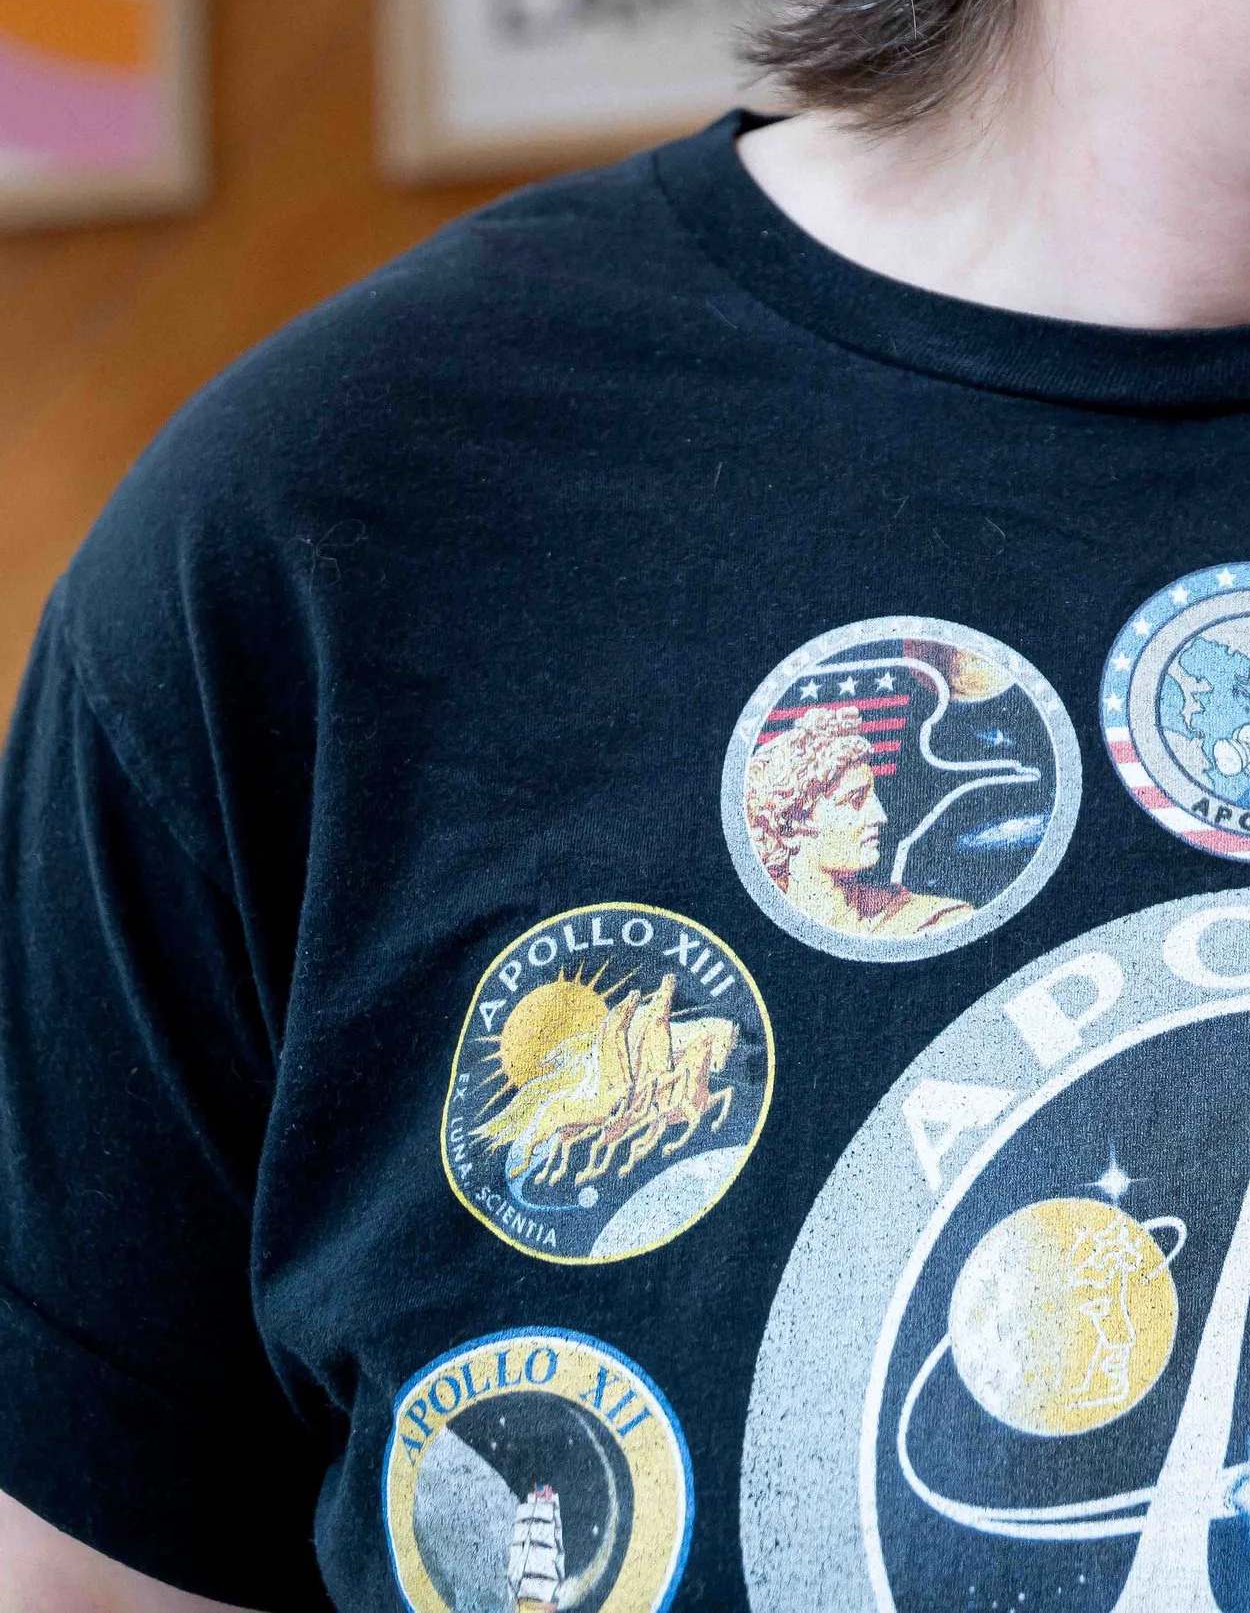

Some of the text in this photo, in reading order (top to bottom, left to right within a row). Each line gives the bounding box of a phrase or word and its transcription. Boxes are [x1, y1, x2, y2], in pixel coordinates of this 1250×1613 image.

[479, 918, 735, 1032] APOLLO XIII
[453, 1073, 470, 1103] EX
[476, 1186, 557, 1247] SCIENTIA
[400, 1346, 653, 1468] APOLLO XII
